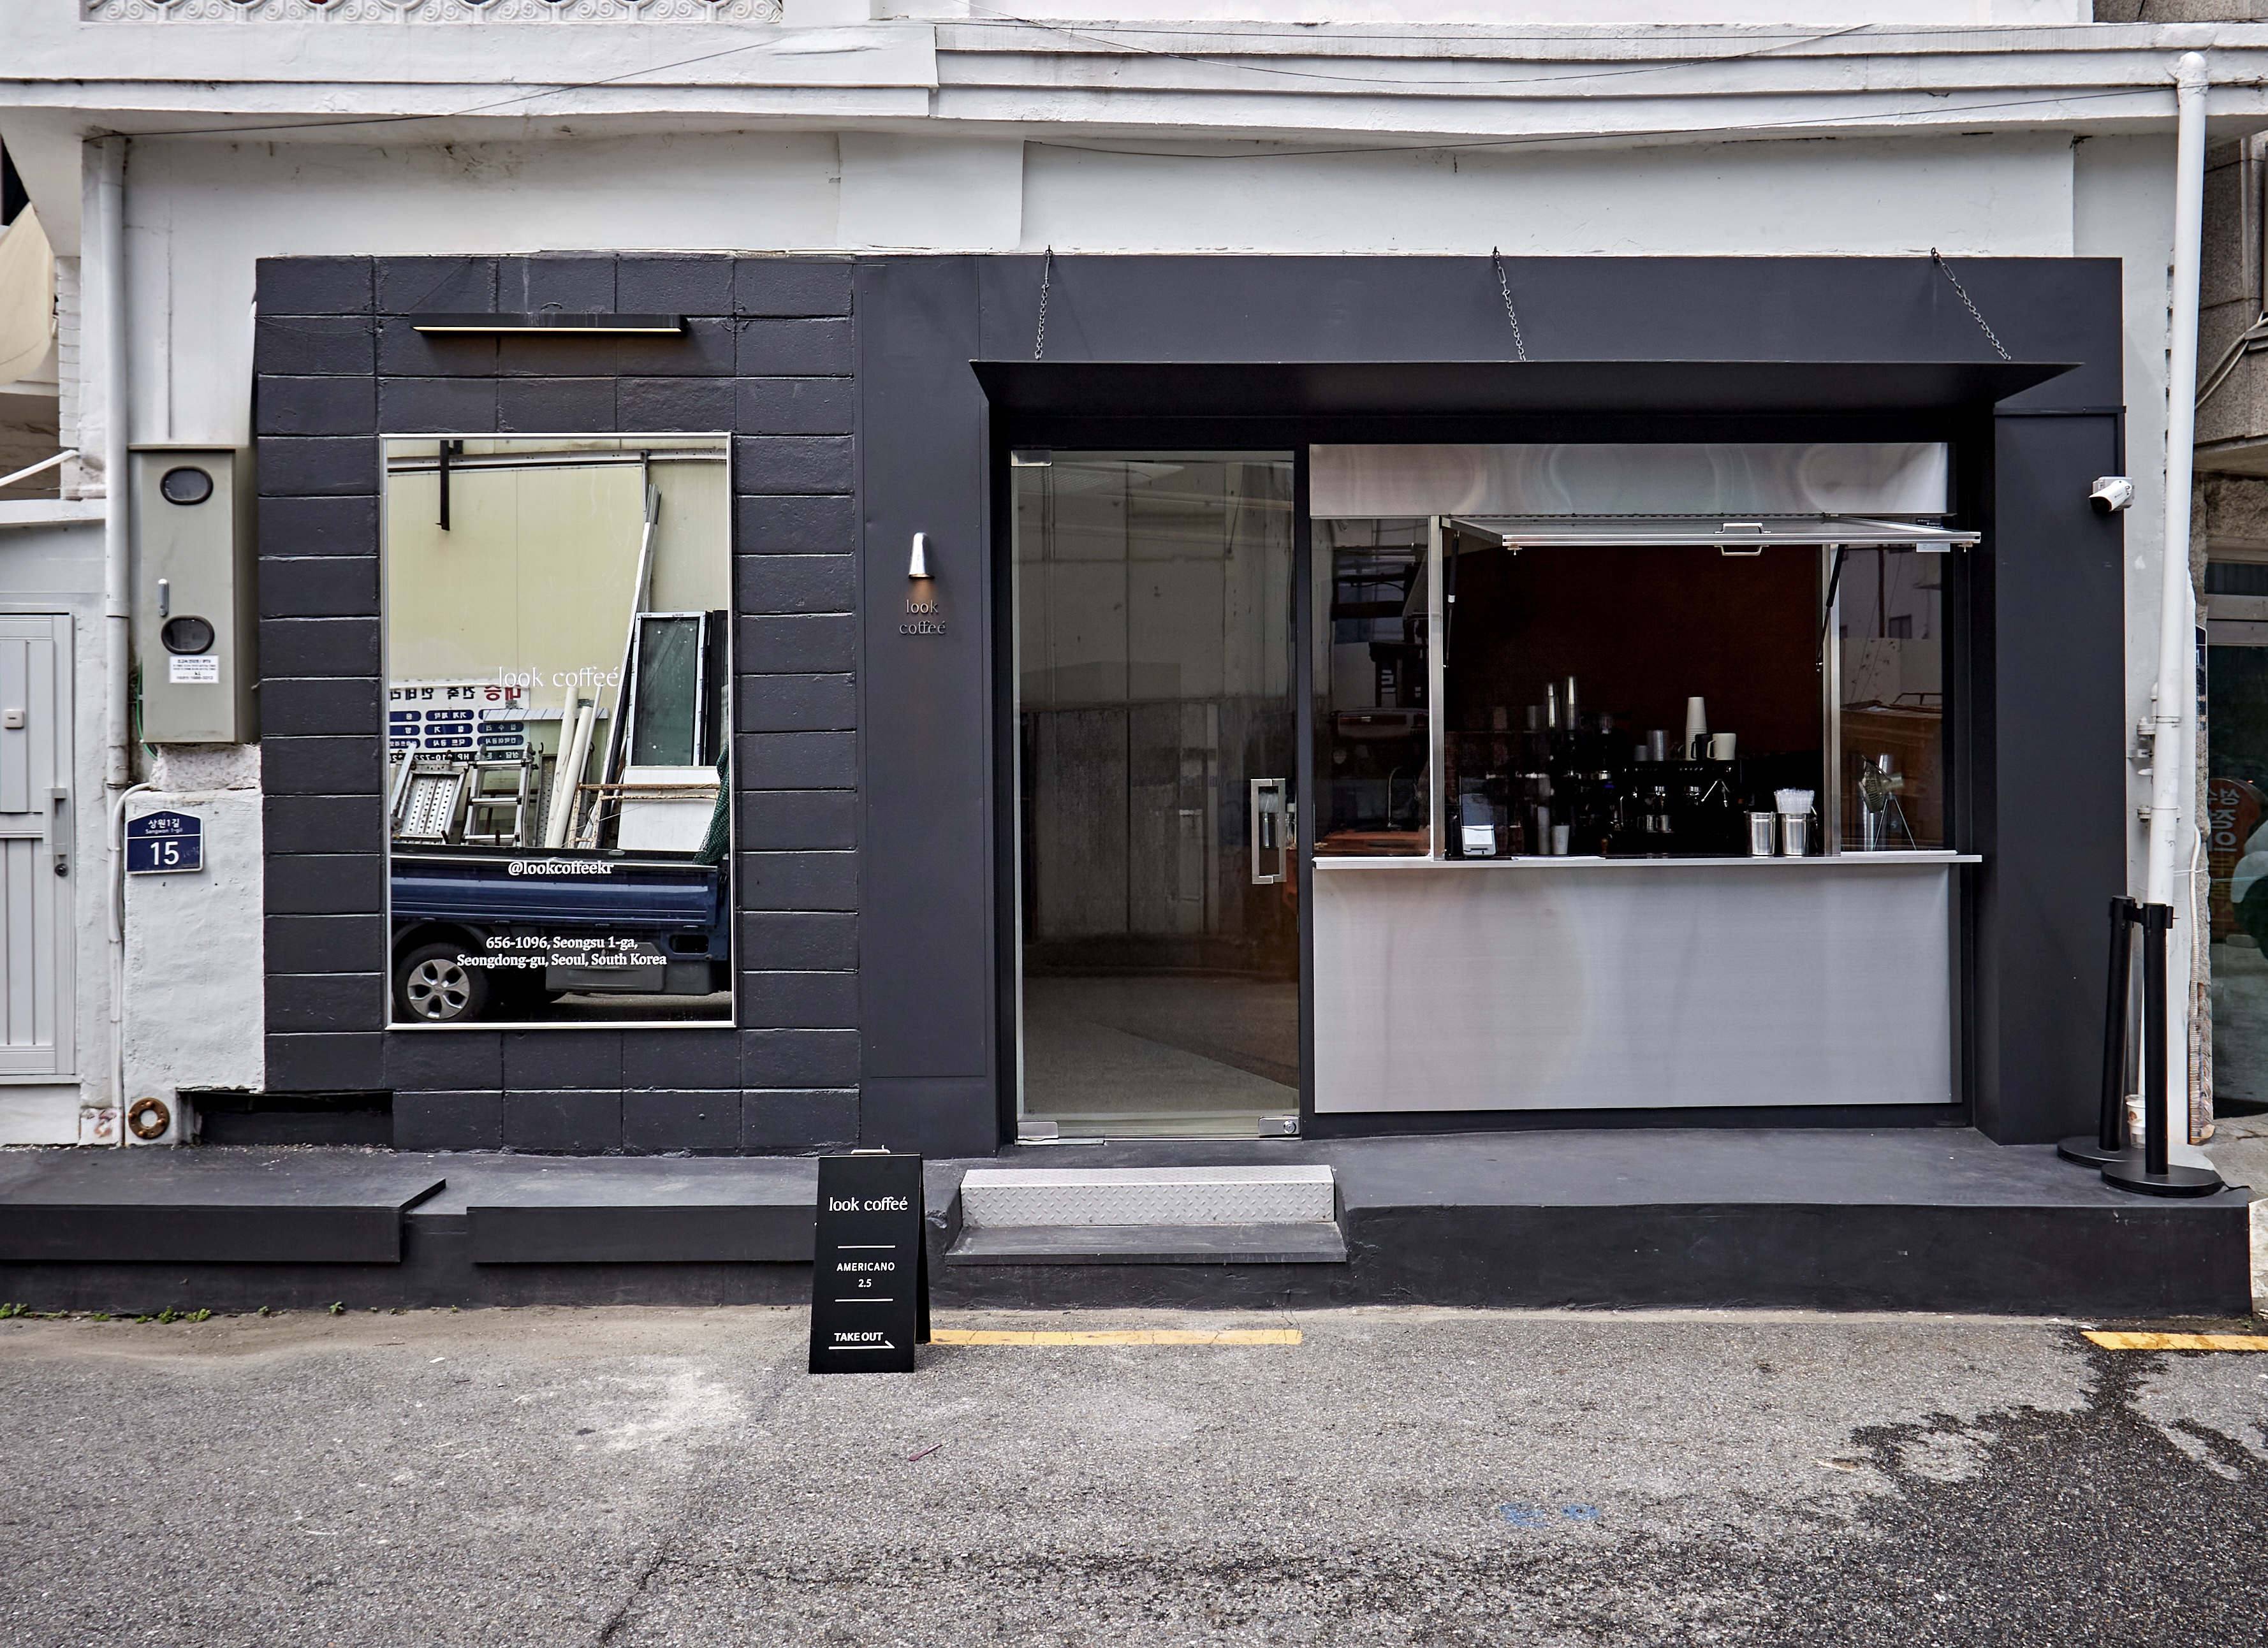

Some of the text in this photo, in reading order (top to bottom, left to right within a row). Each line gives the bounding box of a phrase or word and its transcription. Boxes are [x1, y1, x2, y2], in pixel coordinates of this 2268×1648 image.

[906, 599, 939, 614] look
[899, 620, 946, 634] coffeé
[498, 666, 543, 688] look
[148, 818, 180, 829] 상원1길
[150, 841, 180, 866] 15
[508, 860, 615, 876] @lookcoffeekr
[486, 936, 638, 950] 656-1096, Seongsu 1-ga,
[457, 953, 668, 968] Seongdong-gu, Seoul, South Korea
[829, 1195, 909, 1211] look coffeé
[836, 1262, 895, 1272] AMERICANO
[858, 1279, 872, 1288] 2.5
[834, 1332, 884, 1341] TAKE OUT
